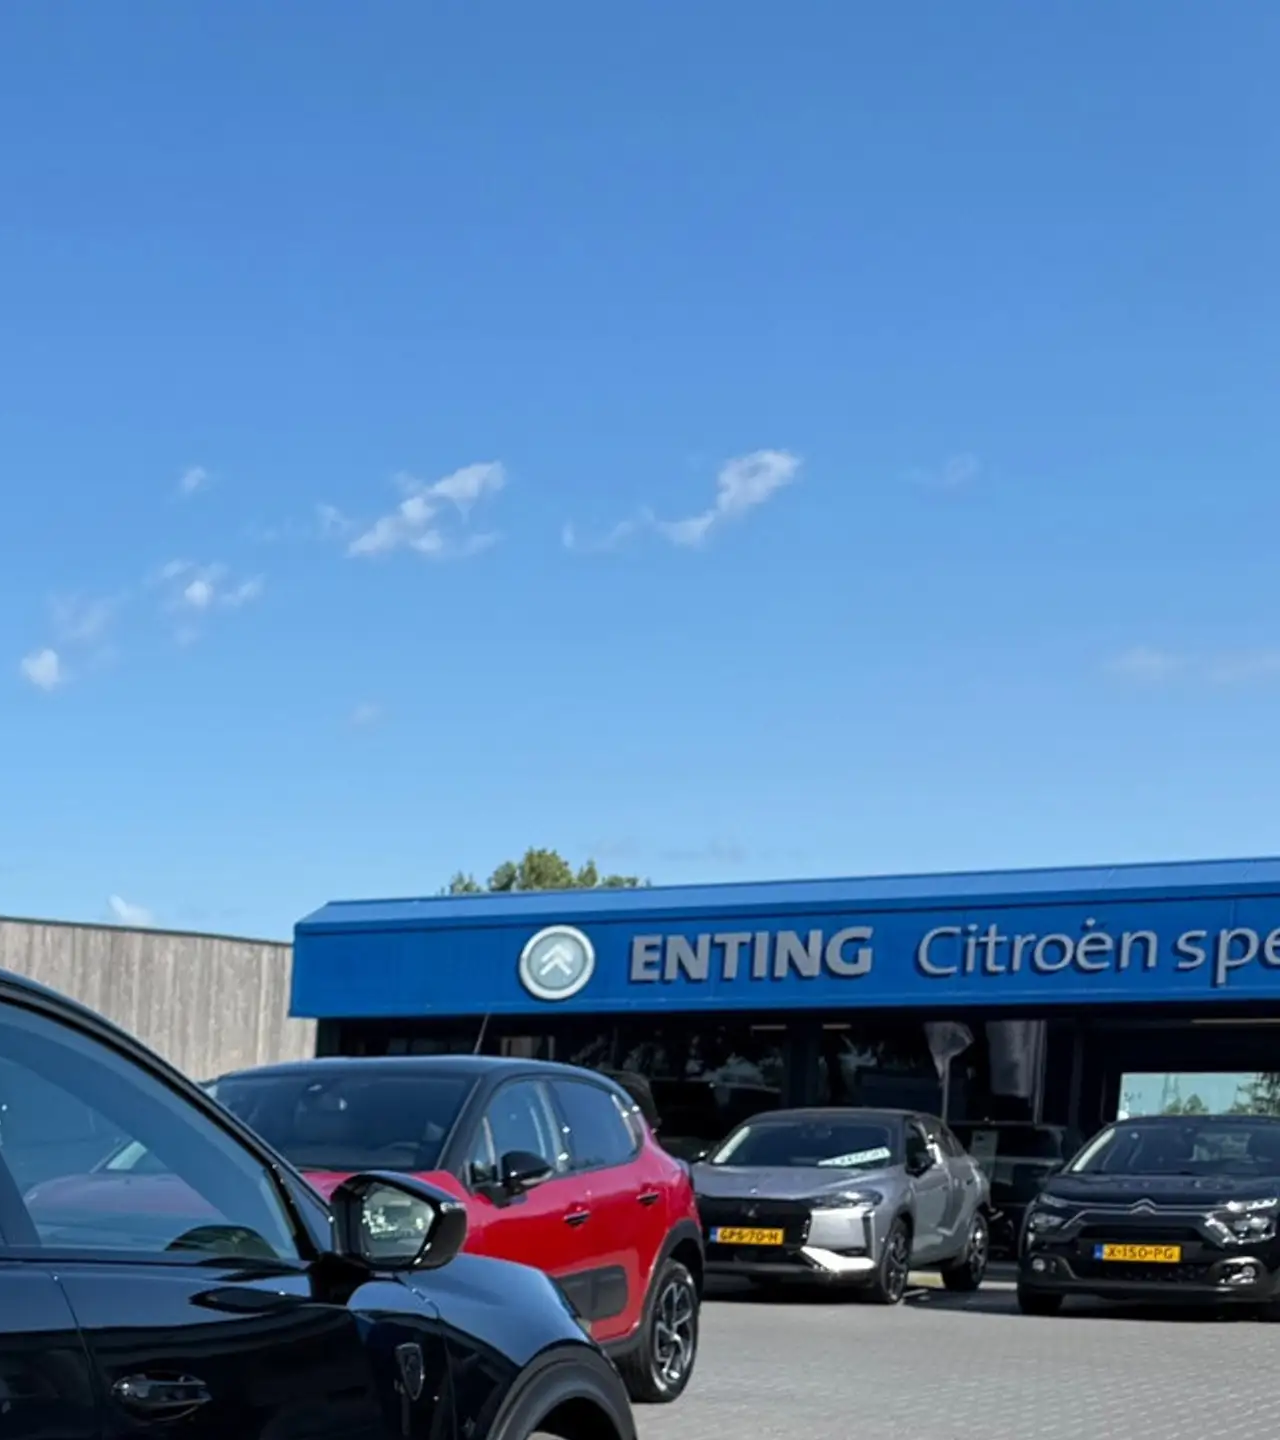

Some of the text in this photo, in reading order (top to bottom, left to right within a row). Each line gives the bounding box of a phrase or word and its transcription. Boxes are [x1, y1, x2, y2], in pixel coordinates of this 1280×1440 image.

[630, 917, 1280, 985] ENTING Citroën spe
